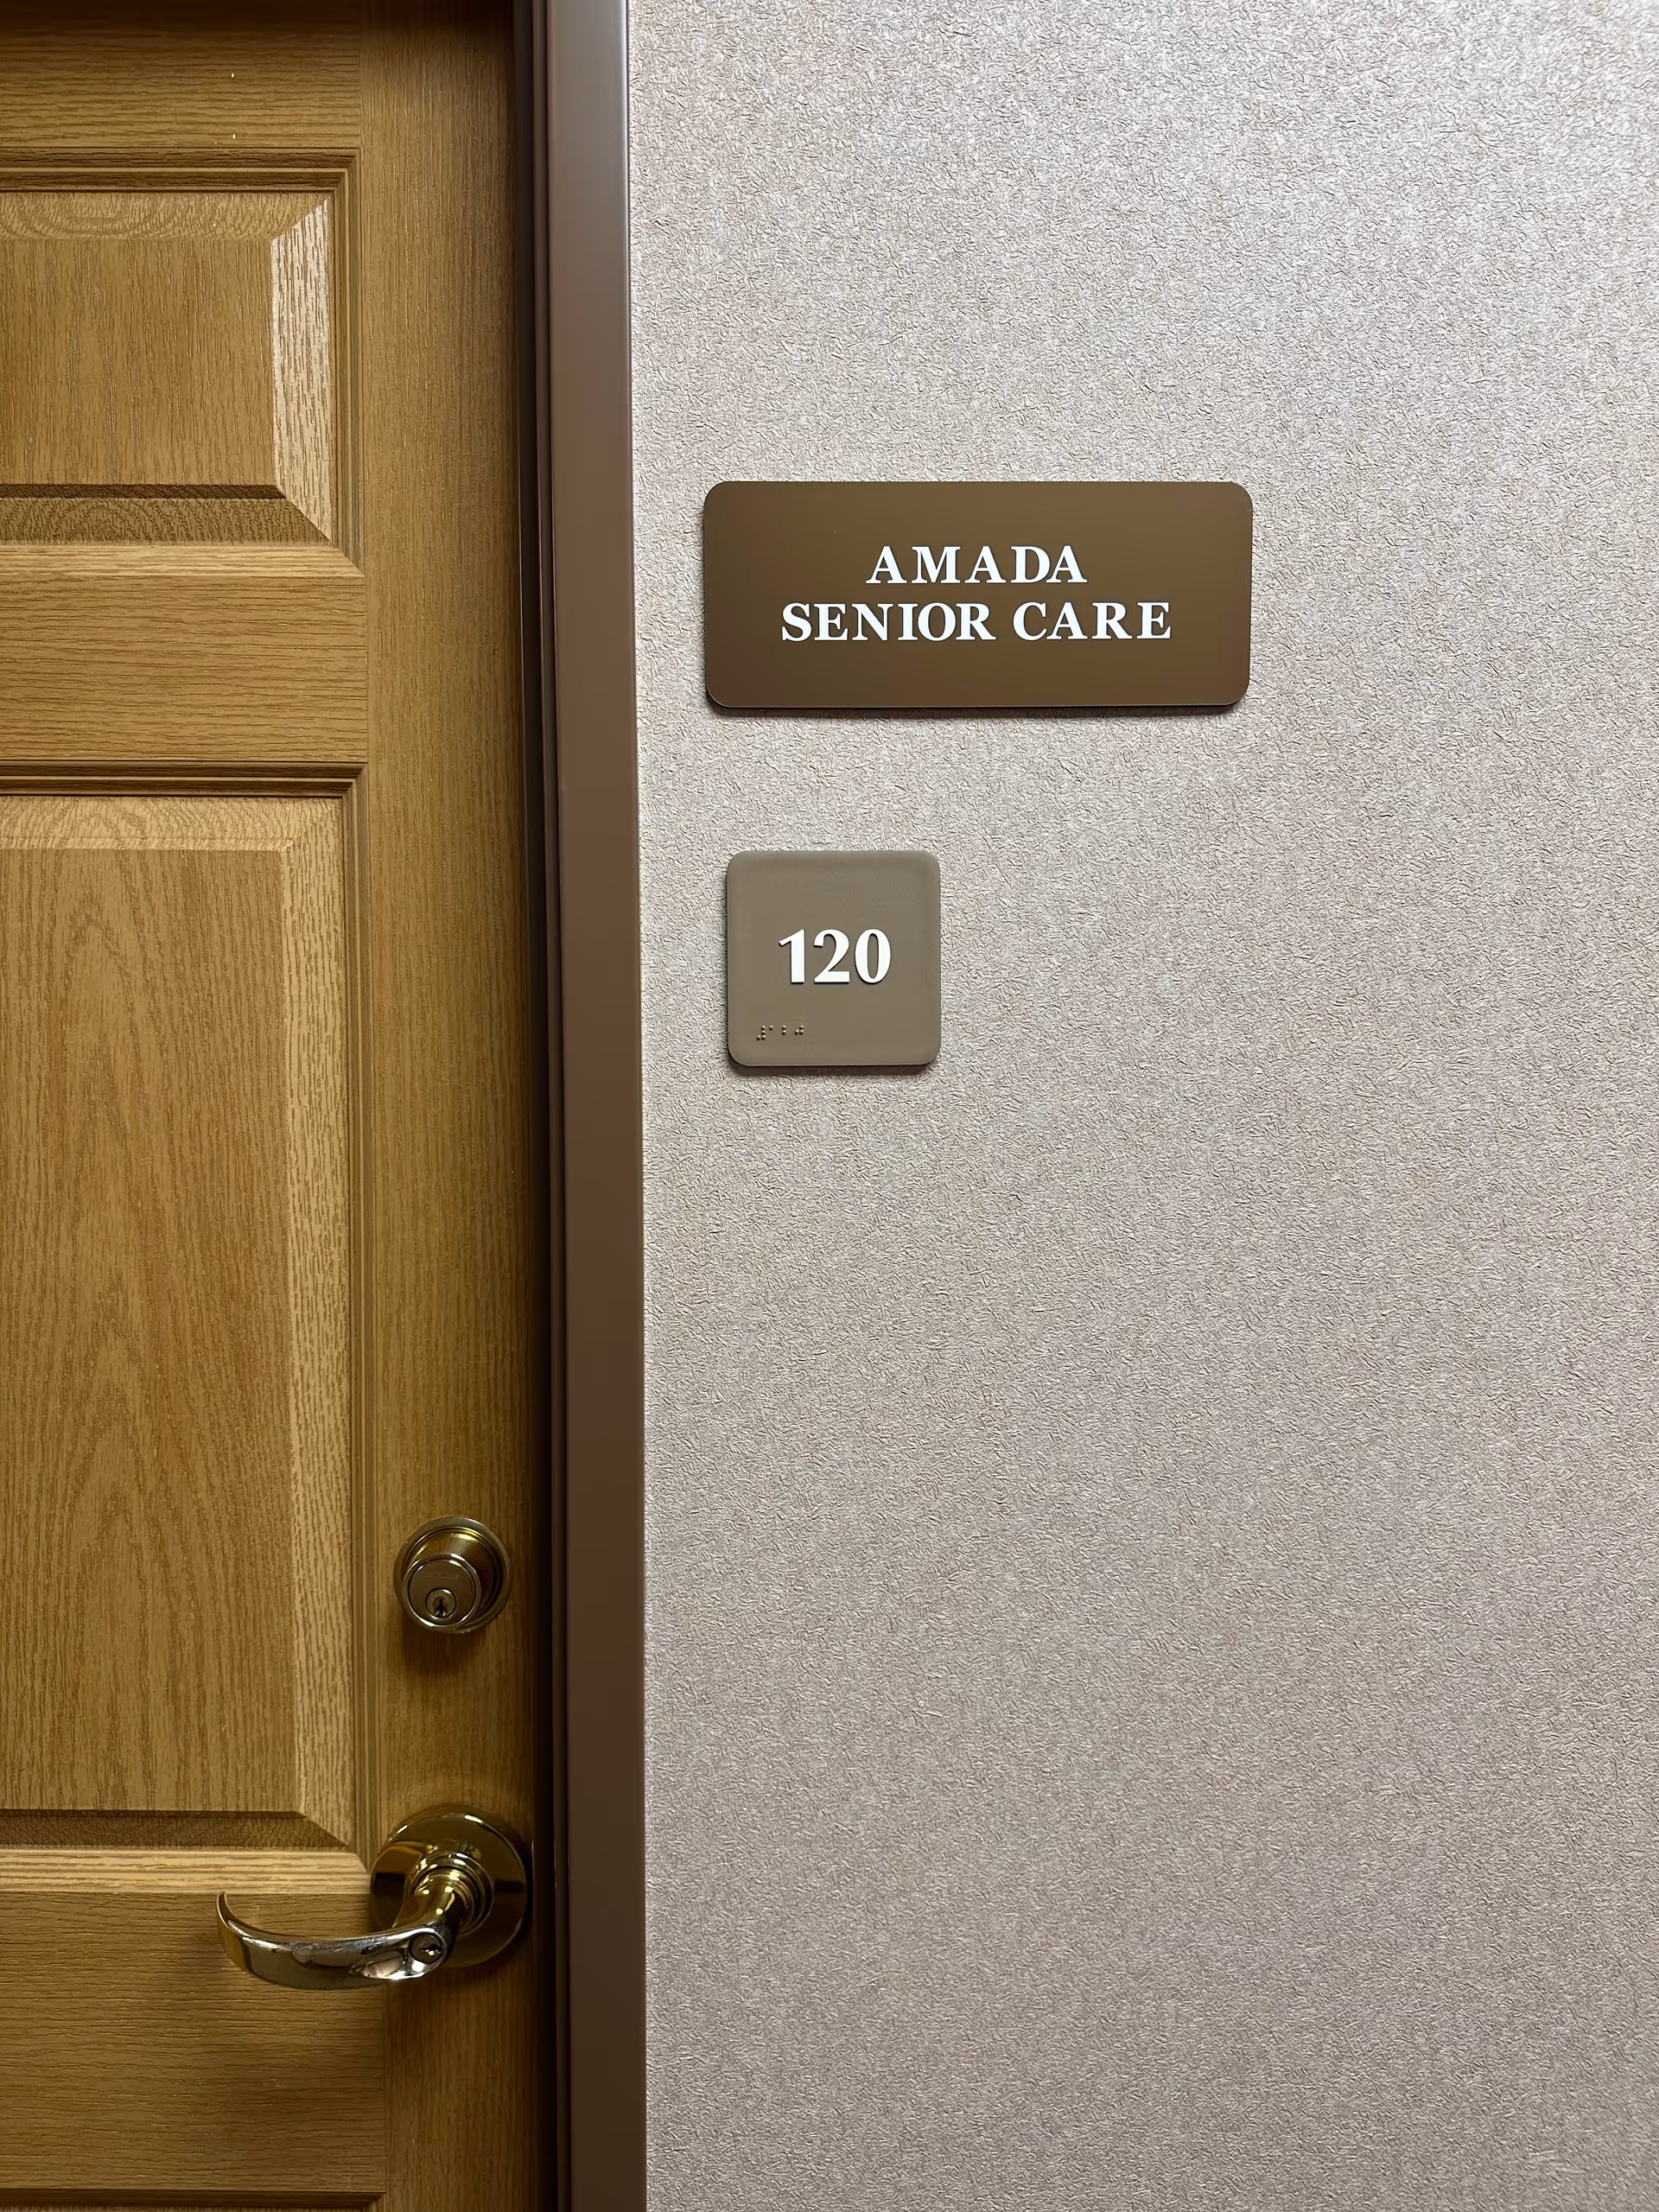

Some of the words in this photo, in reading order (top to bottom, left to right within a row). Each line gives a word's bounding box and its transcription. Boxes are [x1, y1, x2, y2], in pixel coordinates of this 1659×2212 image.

[865, 545, 1088, 585] AMADA
[781, 602, 996, 642] SENIOR
[1013, 601, 1173, 641] CARE
[779, 928, 892, 984] 120
